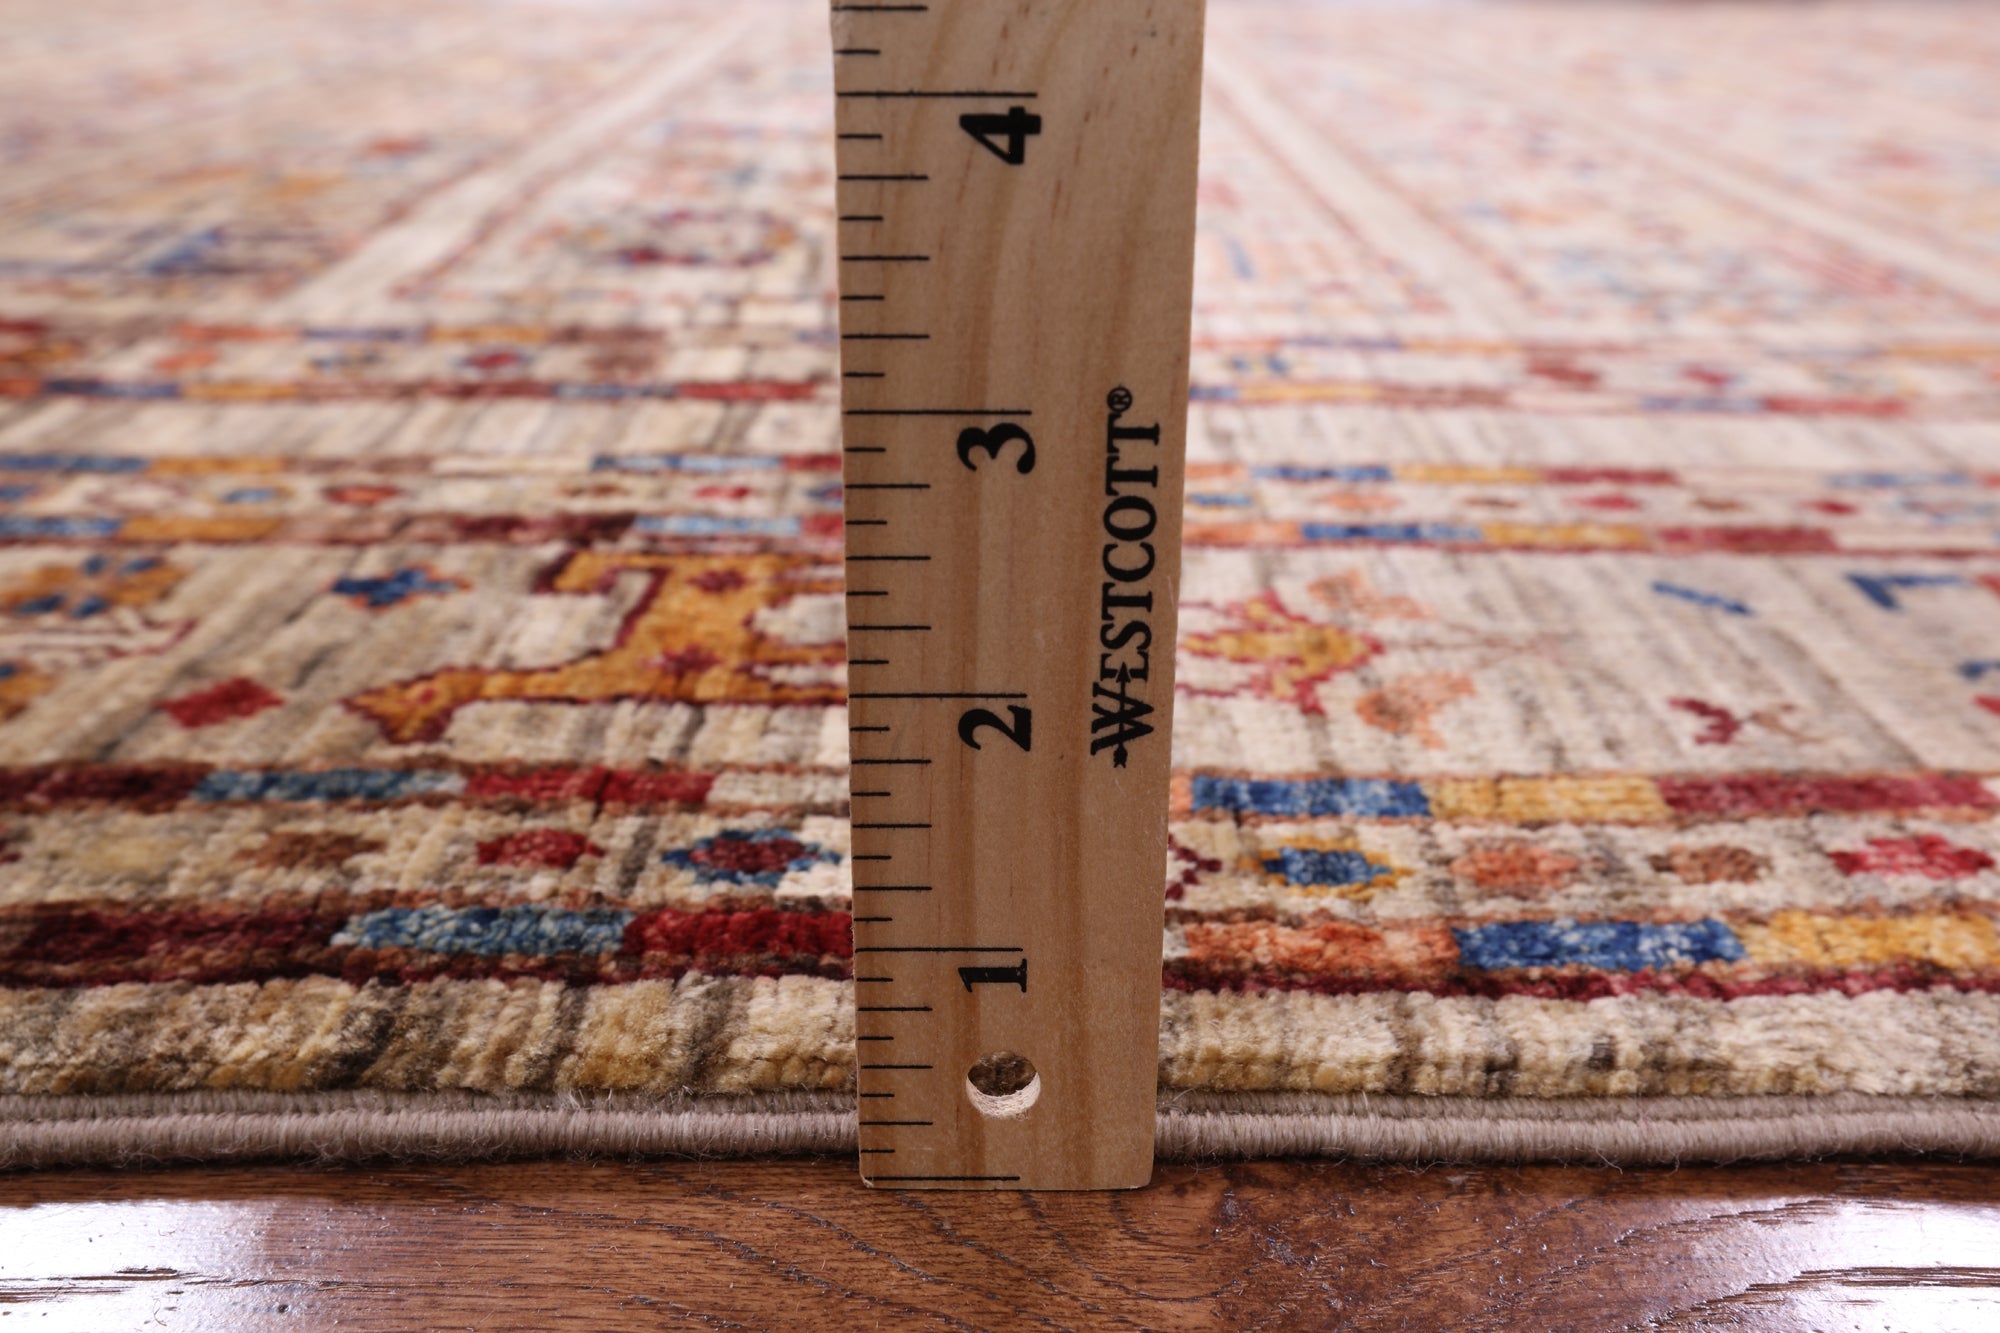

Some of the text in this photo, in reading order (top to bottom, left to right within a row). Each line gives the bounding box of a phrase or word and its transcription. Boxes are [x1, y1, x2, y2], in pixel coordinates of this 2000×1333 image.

[958, 106, 1042, 166] 4
[956, 421, 1037, 475] 3
[956, 703, 1032, 752] 2
[957, 958, 1028, 993] 1
